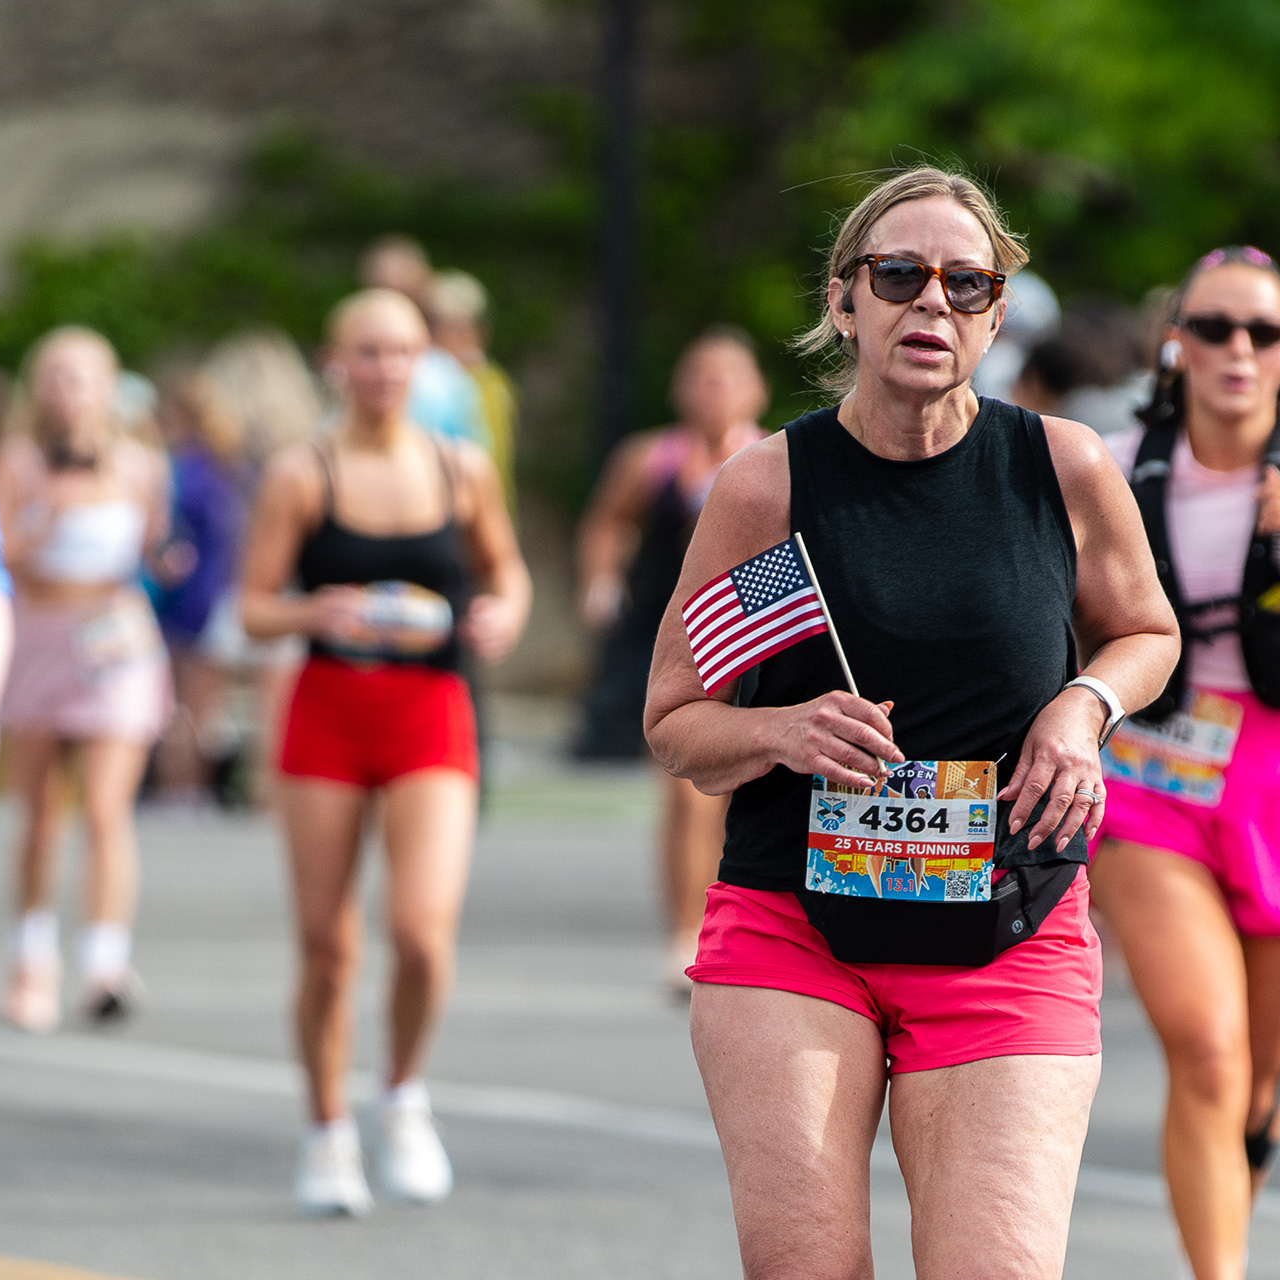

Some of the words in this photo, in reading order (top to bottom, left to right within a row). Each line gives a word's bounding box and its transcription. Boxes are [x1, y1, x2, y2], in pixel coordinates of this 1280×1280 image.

[858, 805, 949, 833] 4364
[834, 837, 852, 849] 25
[856, 840, 903, 854] YEARS
[906, 843, 970, 856] RUNNING
[886, 878, 914, 892] 13.1
